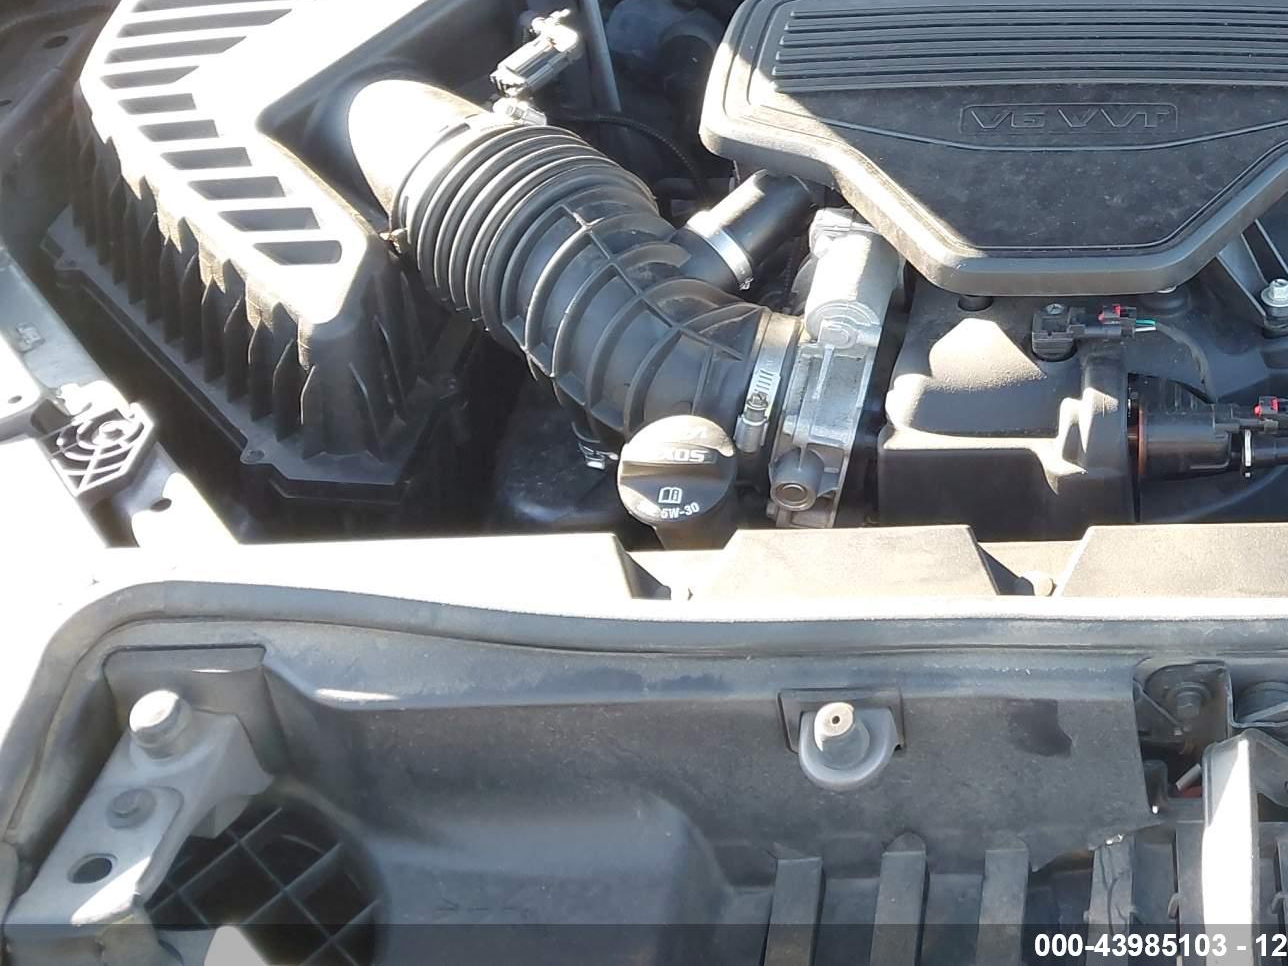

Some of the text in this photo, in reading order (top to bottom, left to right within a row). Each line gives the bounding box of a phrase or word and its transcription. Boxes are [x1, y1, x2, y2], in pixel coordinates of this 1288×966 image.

[971, 107, 1170, 128] V6 VVT
[660, 502, 700, 519] 5W-30
